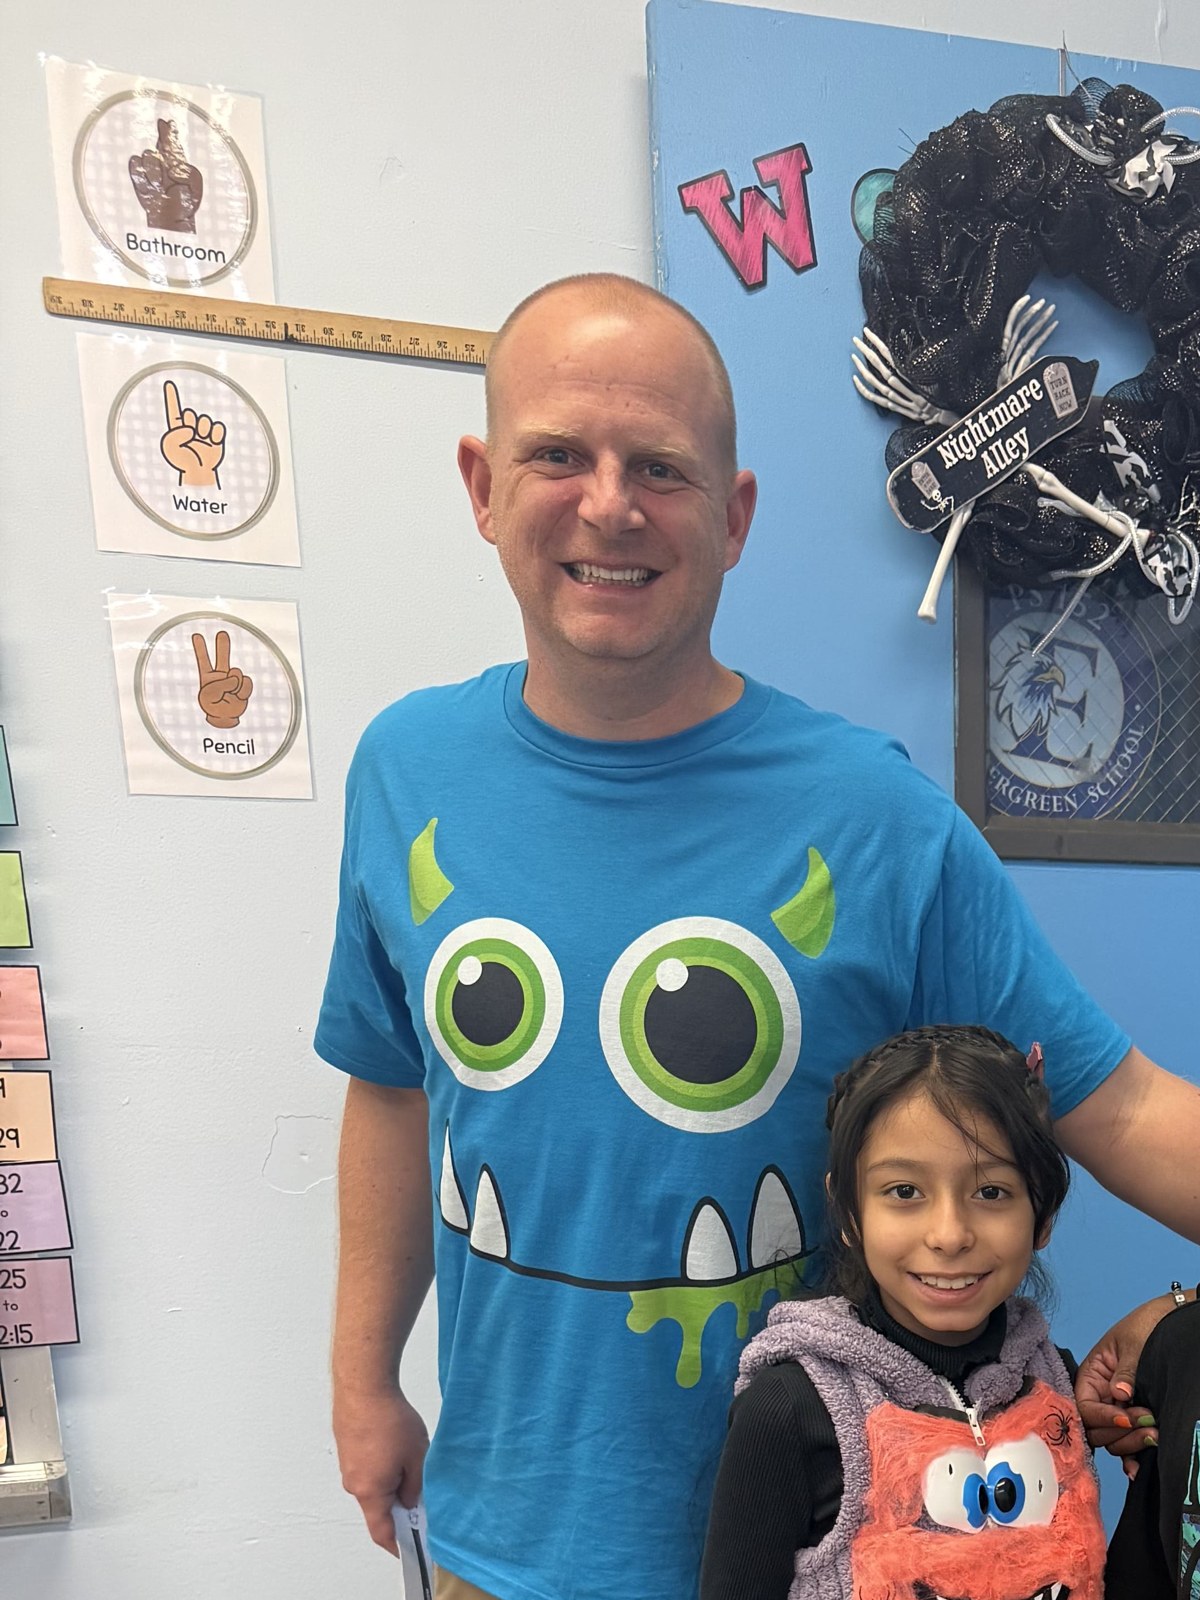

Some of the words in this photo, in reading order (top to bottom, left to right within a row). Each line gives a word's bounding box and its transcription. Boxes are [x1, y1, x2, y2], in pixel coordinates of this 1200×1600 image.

[126, 233, 226, 263] Bathroom
[81, 298, 94, 308] 38
[113, 302, 125, 312] 37
[144, 306, 156, 315] 36
[175, 309, 187, 319] 35
[205, 313, 217, 323] 34
[235, 317, 247, 326] 33
[265, 320, 277, 330] 32
[295, 323, 306, 333] 31
[323, 327, 335, 336] 30
[351, 330, 363, 340] 29
[380, 334, 392, 343] 28
[409, 337, 420, 346] 27
[437, 340, 448, 349] 26
[464, 343, 475, 353] 25
[936, 378, 1044, 470] Nightmare
[980, 427, 1030, 479] Alley
[172, 494, 228, 514] Water
[203, 738, 255, 755] Pencil
[1087, 723, 1145, 804] SCHOOL
[3, 1300, 19, 1311] to
